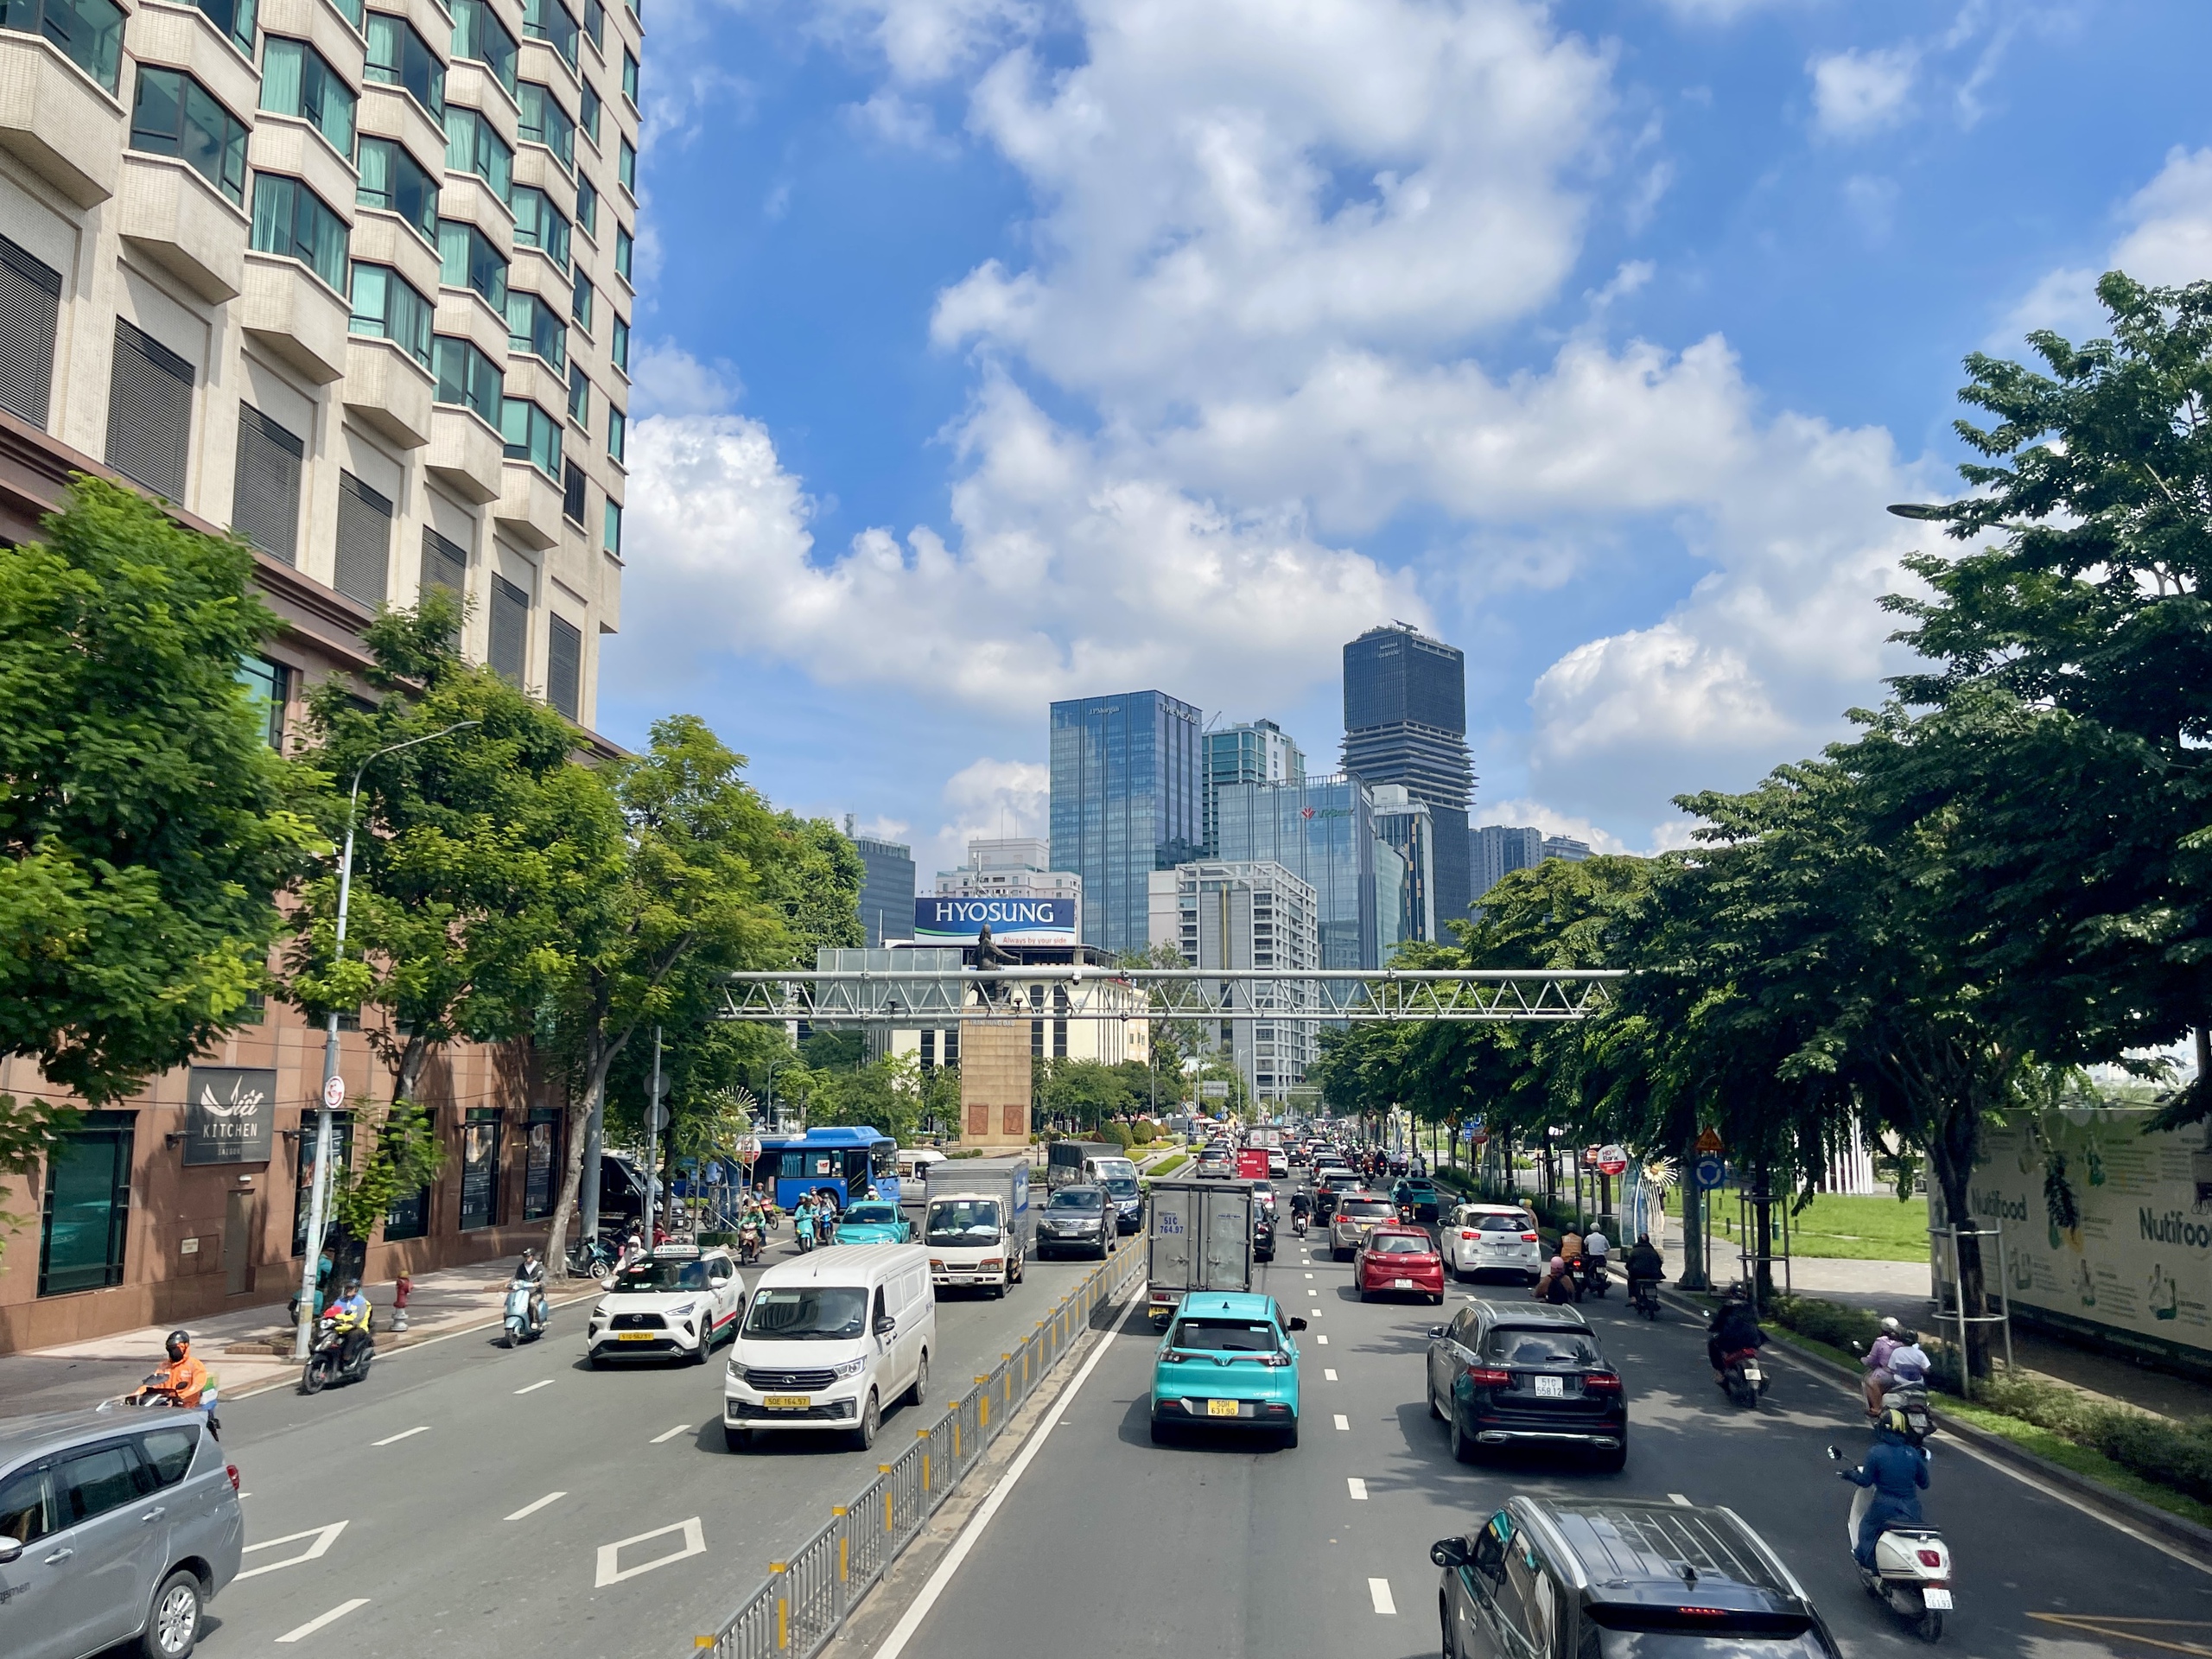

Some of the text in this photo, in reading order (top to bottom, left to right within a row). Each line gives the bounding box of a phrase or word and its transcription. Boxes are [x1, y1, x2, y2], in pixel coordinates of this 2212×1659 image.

[936, 902, 1054, 923] HYOSUNG
[1003, 936, 1027, 945] Always
[1028, 937, 1036, 945] by
[203, 1122, 257, 1139] KITCHEN
[1971, 1187, 2027, 1221] Nutifood
[1164, 1217, 1178, 1225] 51C
[2139, 1206, 2212, 1248] Nutifoo
[1160, 1225, 1184, 1235] 764.97
